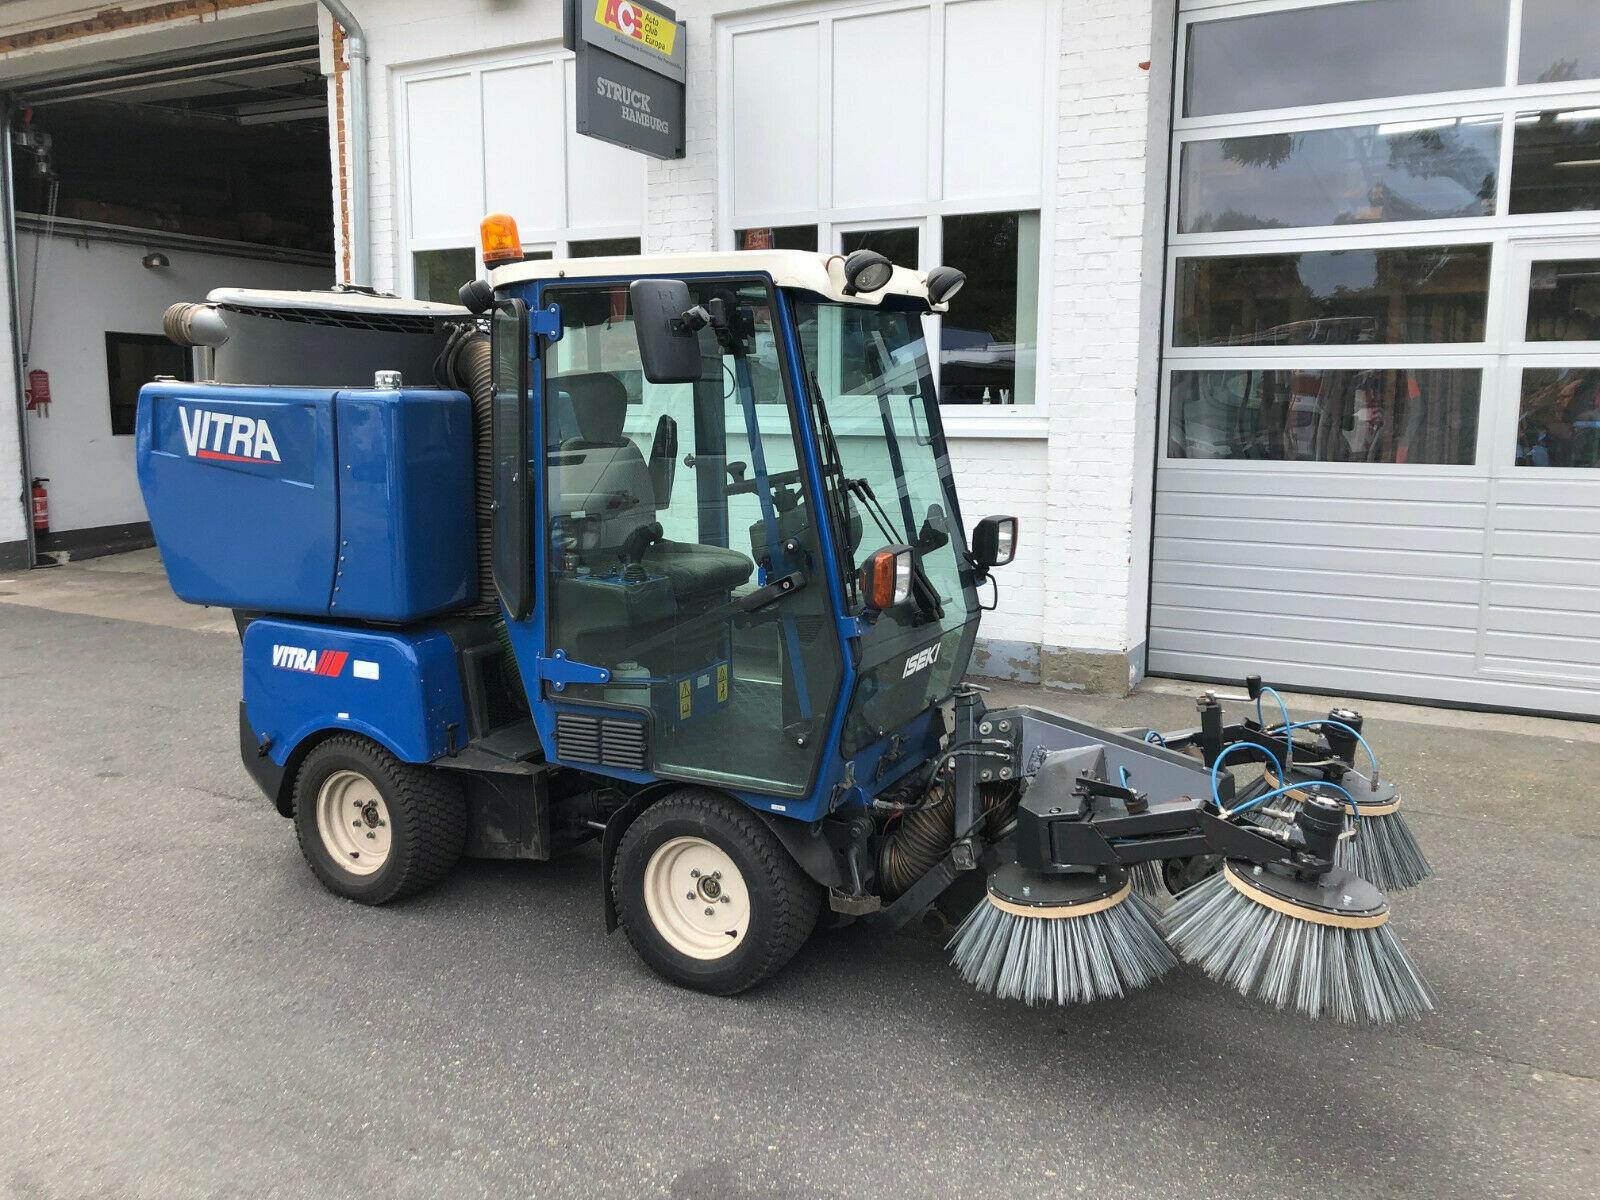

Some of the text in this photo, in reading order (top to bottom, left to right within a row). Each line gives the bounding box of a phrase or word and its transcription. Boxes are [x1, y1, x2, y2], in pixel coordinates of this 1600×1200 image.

[605, 0, 643, 40] ACE
[644, 24, 659, 37] Club
[645, 13, 659, 27] Auto
[644, 34, 666, 51] Europa
[596, 76, 651, 112] STRUCK
[621, 106, 669, 134] HAMBURG
[178, 406, 281, 462] VITRA
[273, 645, 317, 671] VITRA
[902, 642, 941, 679] ISEKI
